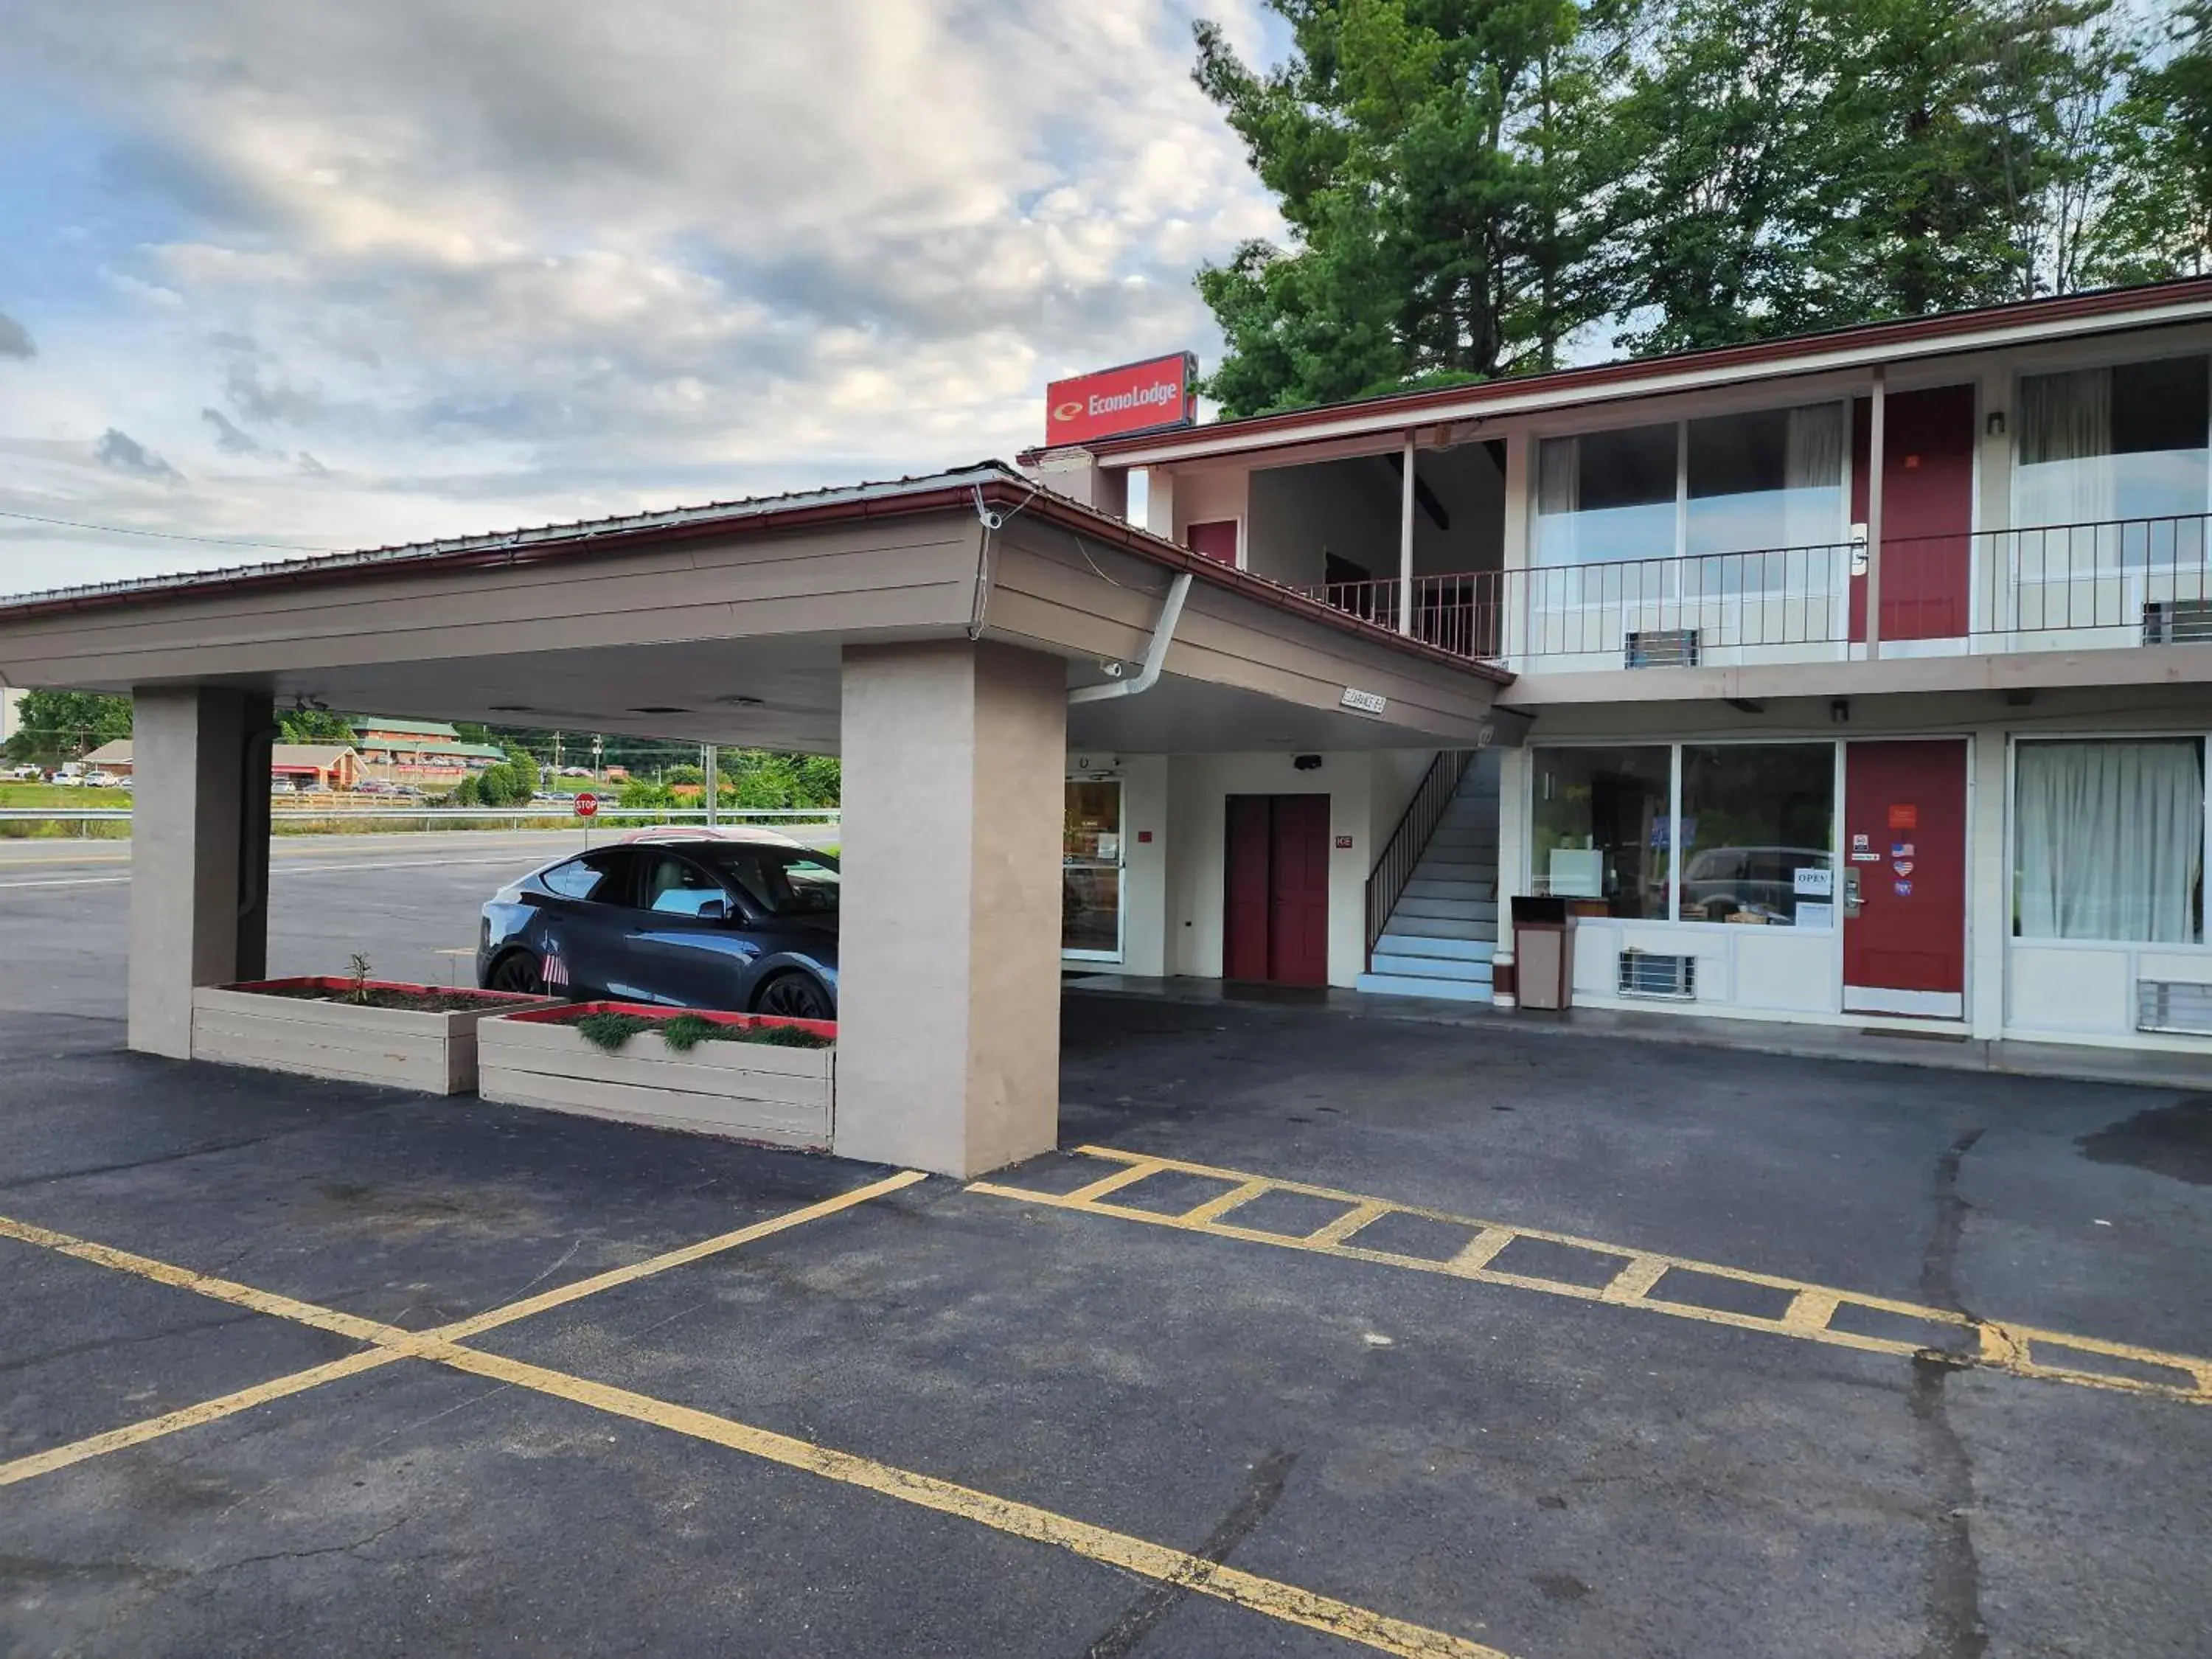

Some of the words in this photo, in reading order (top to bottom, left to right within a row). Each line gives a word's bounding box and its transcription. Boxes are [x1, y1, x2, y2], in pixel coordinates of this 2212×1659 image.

[1088, 381, 1177, 415] EconoLodge
[576, 800, 597, 809] STOP
[1798, 874, 1828, 883] OPEN
